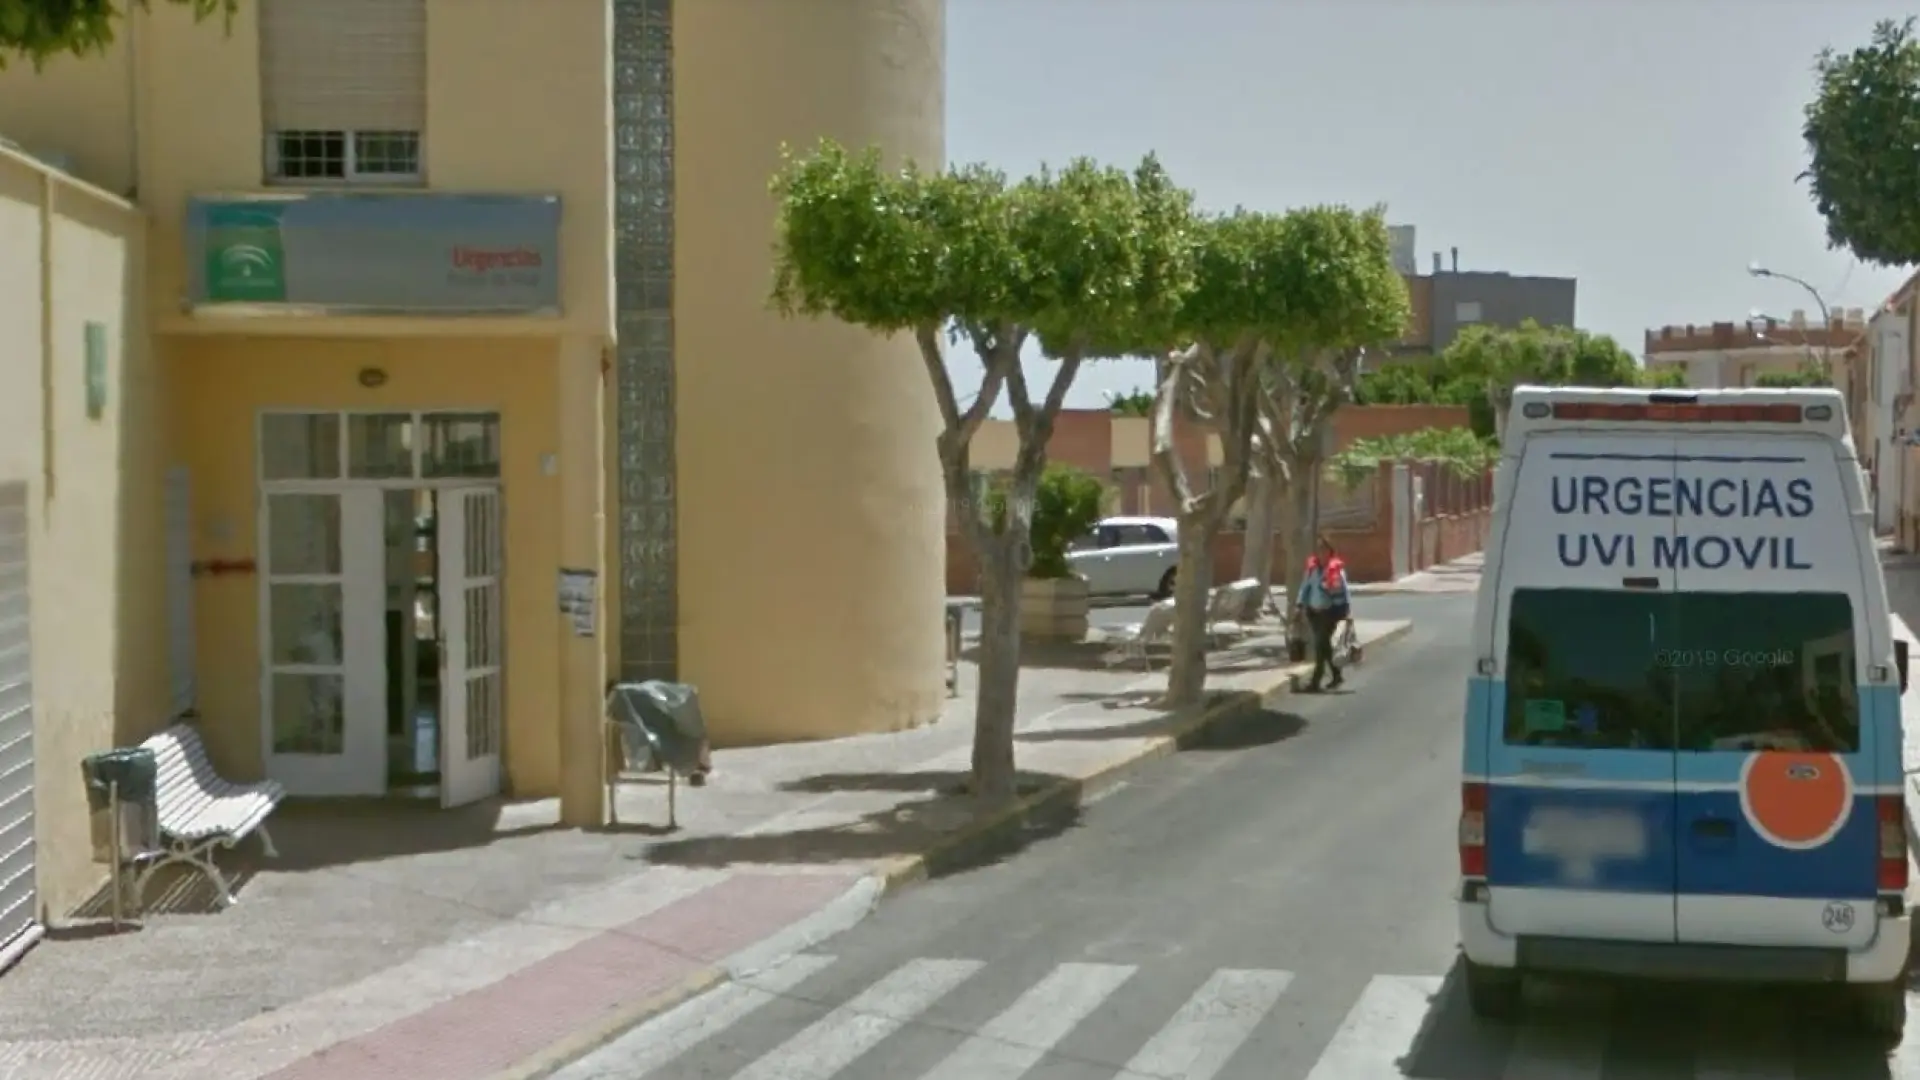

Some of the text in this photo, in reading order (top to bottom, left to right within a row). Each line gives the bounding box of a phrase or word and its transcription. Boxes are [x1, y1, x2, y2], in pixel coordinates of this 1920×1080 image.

[452, 246, 542, 272] Urgencias
[1551, 475, 1813, 518] URGENCIAS
[1557, 532, 1812, 570] UVI MOVIL
